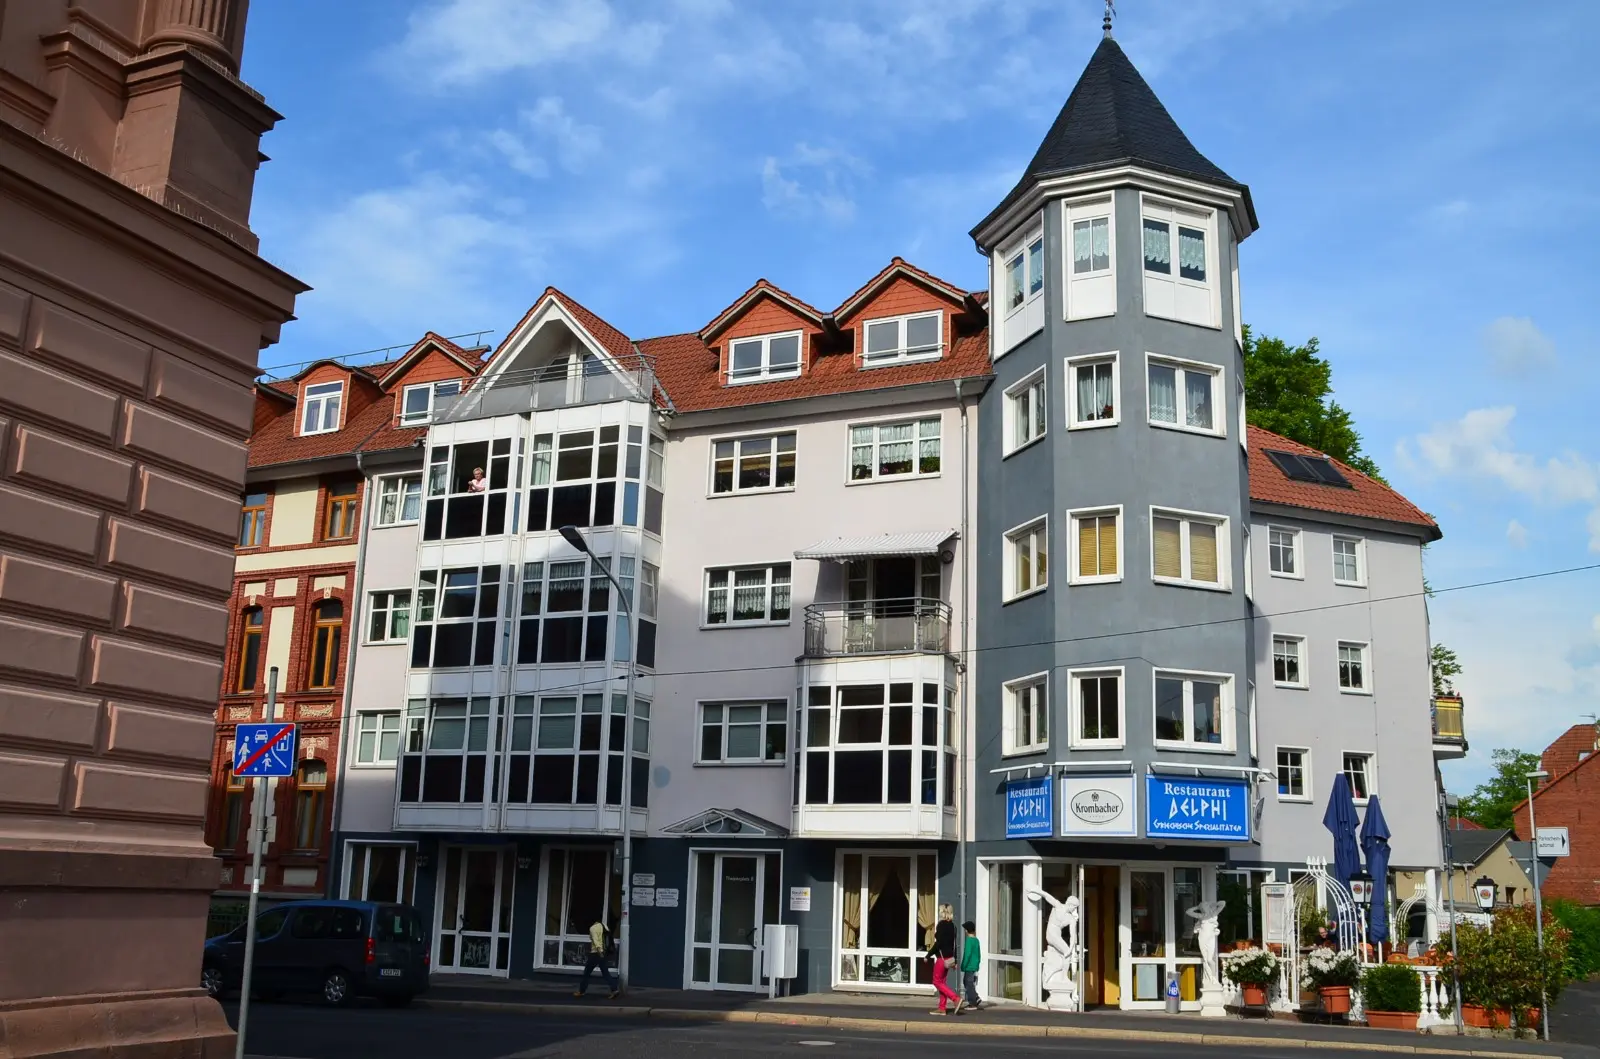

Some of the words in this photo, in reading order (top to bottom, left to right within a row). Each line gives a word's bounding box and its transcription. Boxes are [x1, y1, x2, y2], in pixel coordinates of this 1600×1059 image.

[1010, 785, 1048, 798] Restaurant
[1164, 782, 1231, 798] Restaurant
[1012, 797, 1046, 821] DELPHI
[1075, 802, 1119, 813] Krombacher
[1169, 797, 1226, 821] DELPHI
